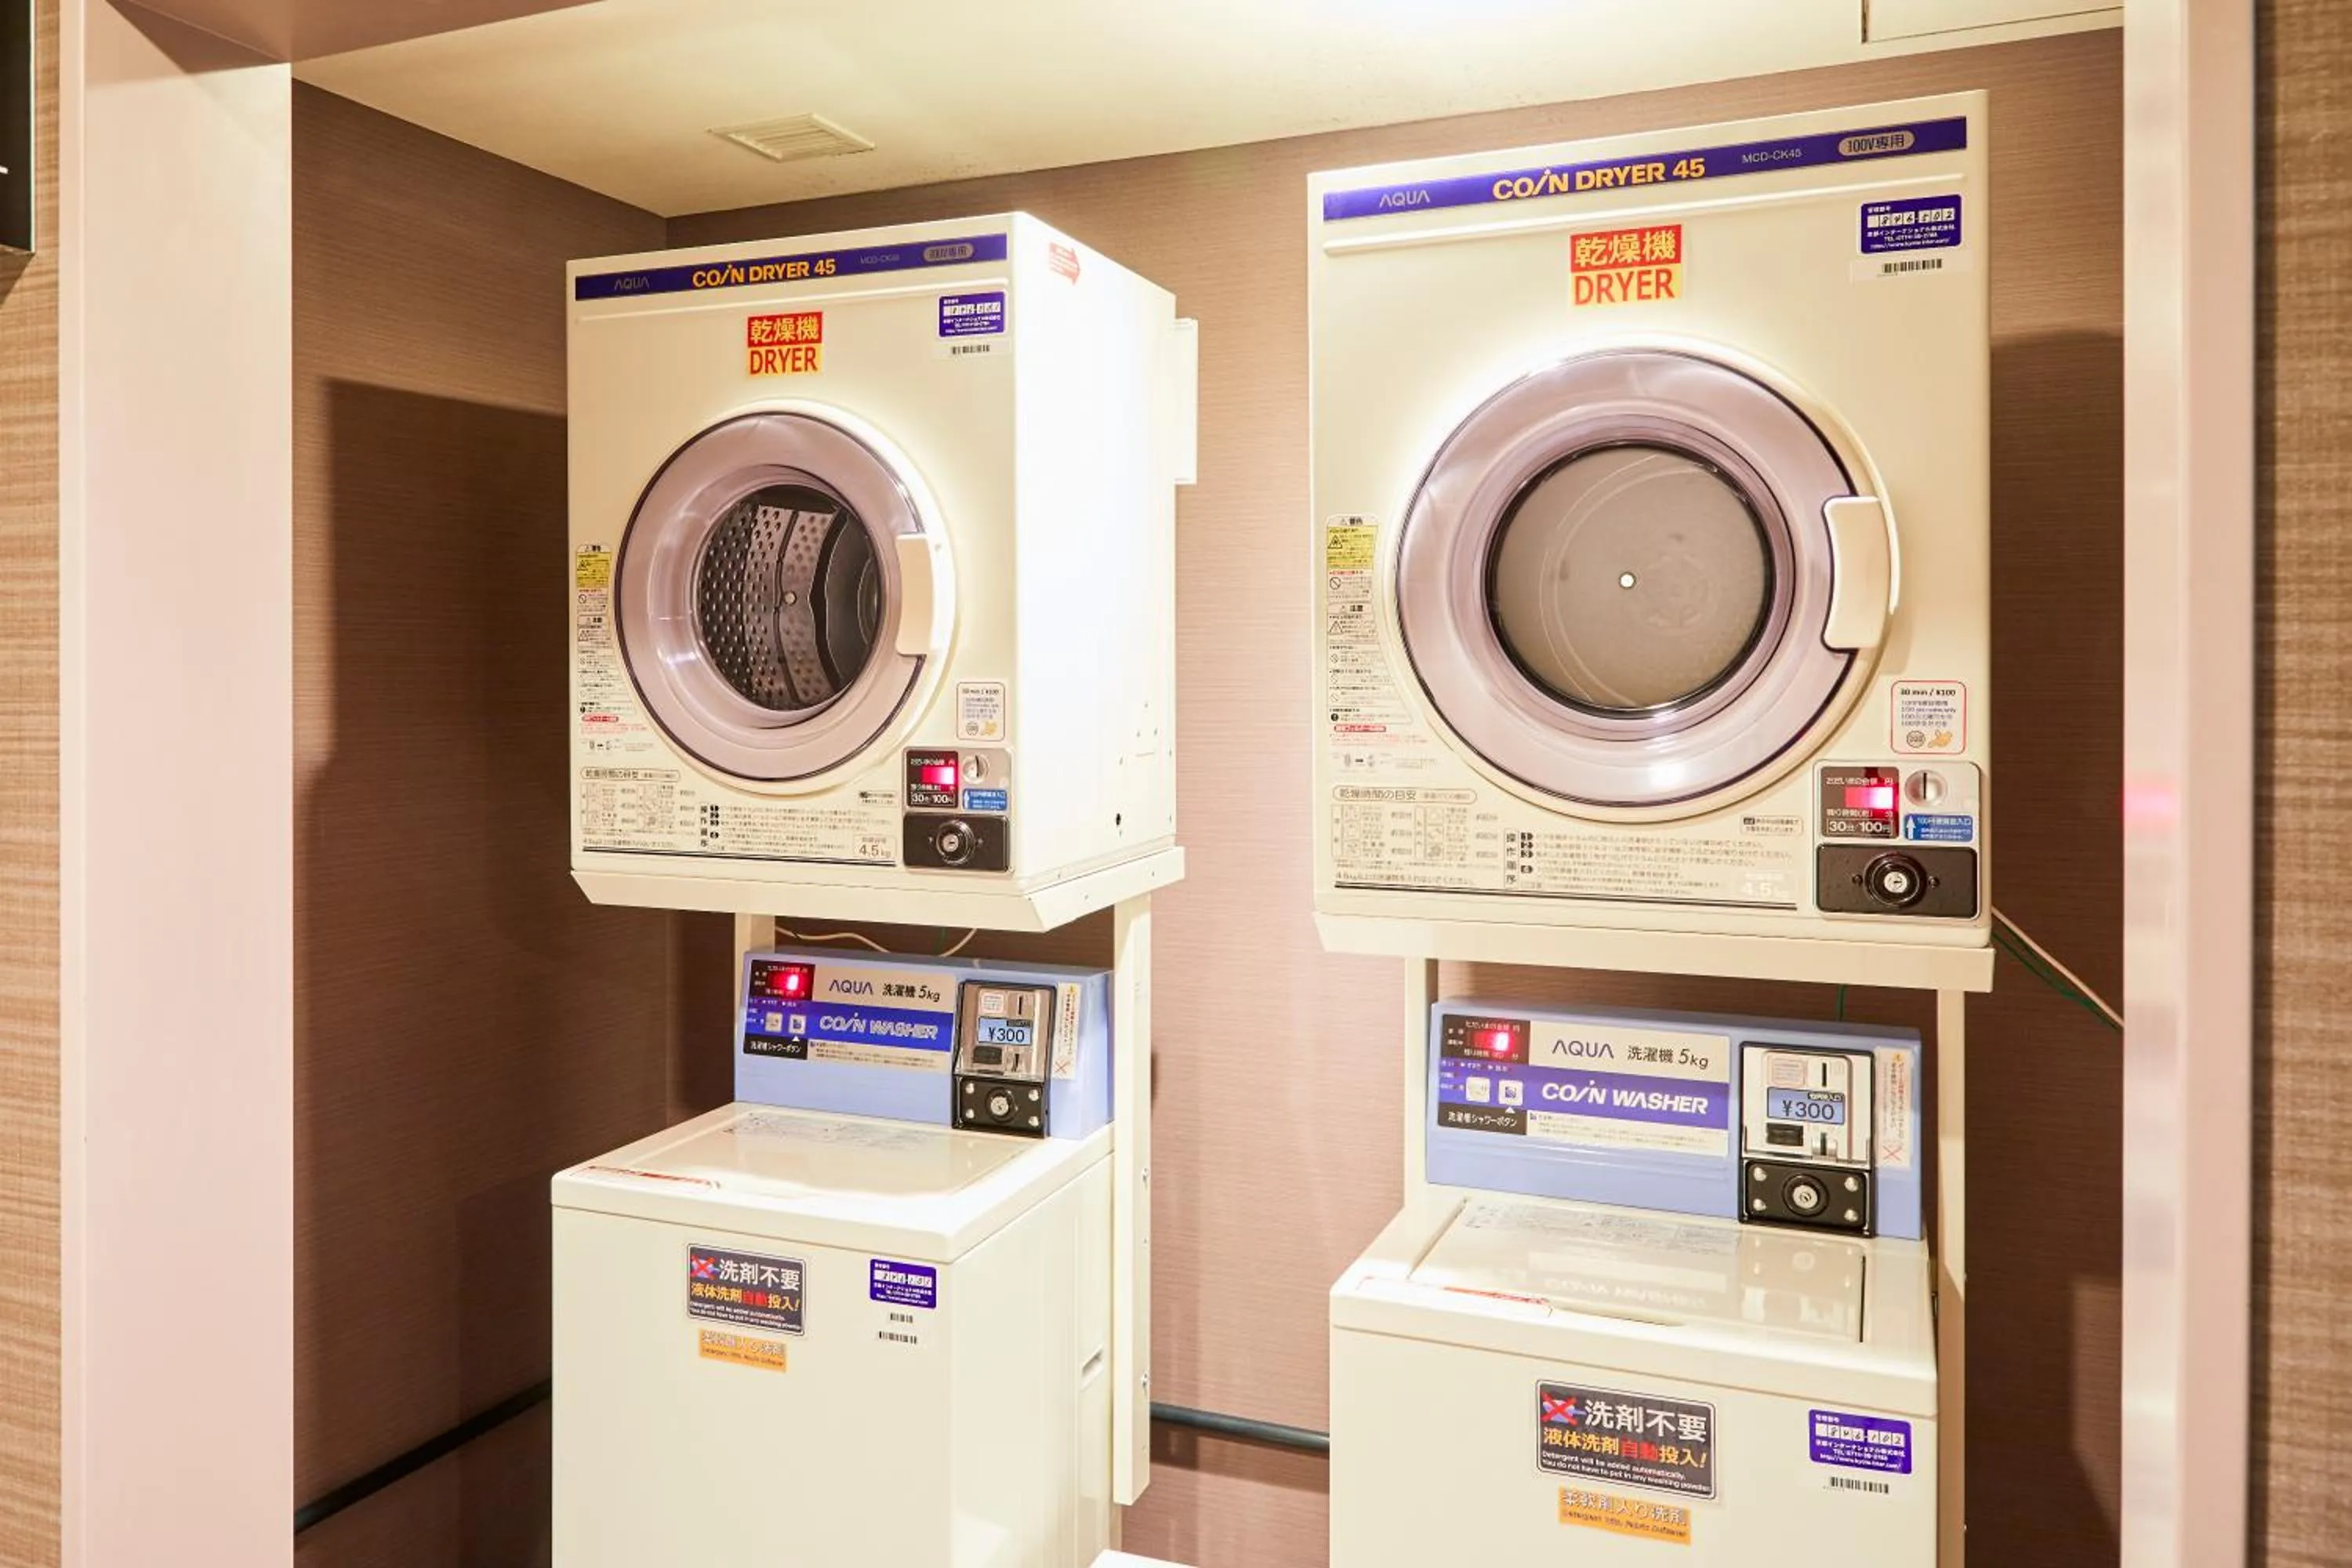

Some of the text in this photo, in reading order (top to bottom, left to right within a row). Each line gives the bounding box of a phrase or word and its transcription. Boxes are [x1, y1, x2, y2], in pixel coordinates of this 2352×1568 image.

[1575, 163, 1666, 191] DRYER
[1671, 158, 1705, 180] 45
[1378, 189, 1431, 209] AQUA
[1574, 230, 1676, 267] 乾燥機
[749, 261, 810, 282] DRYER
[814, 259, 836, 275] 45
[1574, 268, 1675, 306] DRYER
[750, 316, 818, 344] 乾燥機
[750, 347, 818, 375] DRYER
[829, 979, 874, 995] AQUA
[918, 985, 941, 1003] 5kg
[869, 1020, 939, 1040] WASHER
[989, 1026, 1025, 1043] ¥300
[1552, 1039, 1614, 1059] AQUA
[1627, 1044, 1708, 1069] 洗濯機 5kg
[1612, 1089, 1708, 1115] WASHER
[1782, 1100, 1835, 1120] ¥300
[719, 1258, 800, 1291] 洗剤不要
[1584, 1399, 1707, 1443] 洗剤不要
